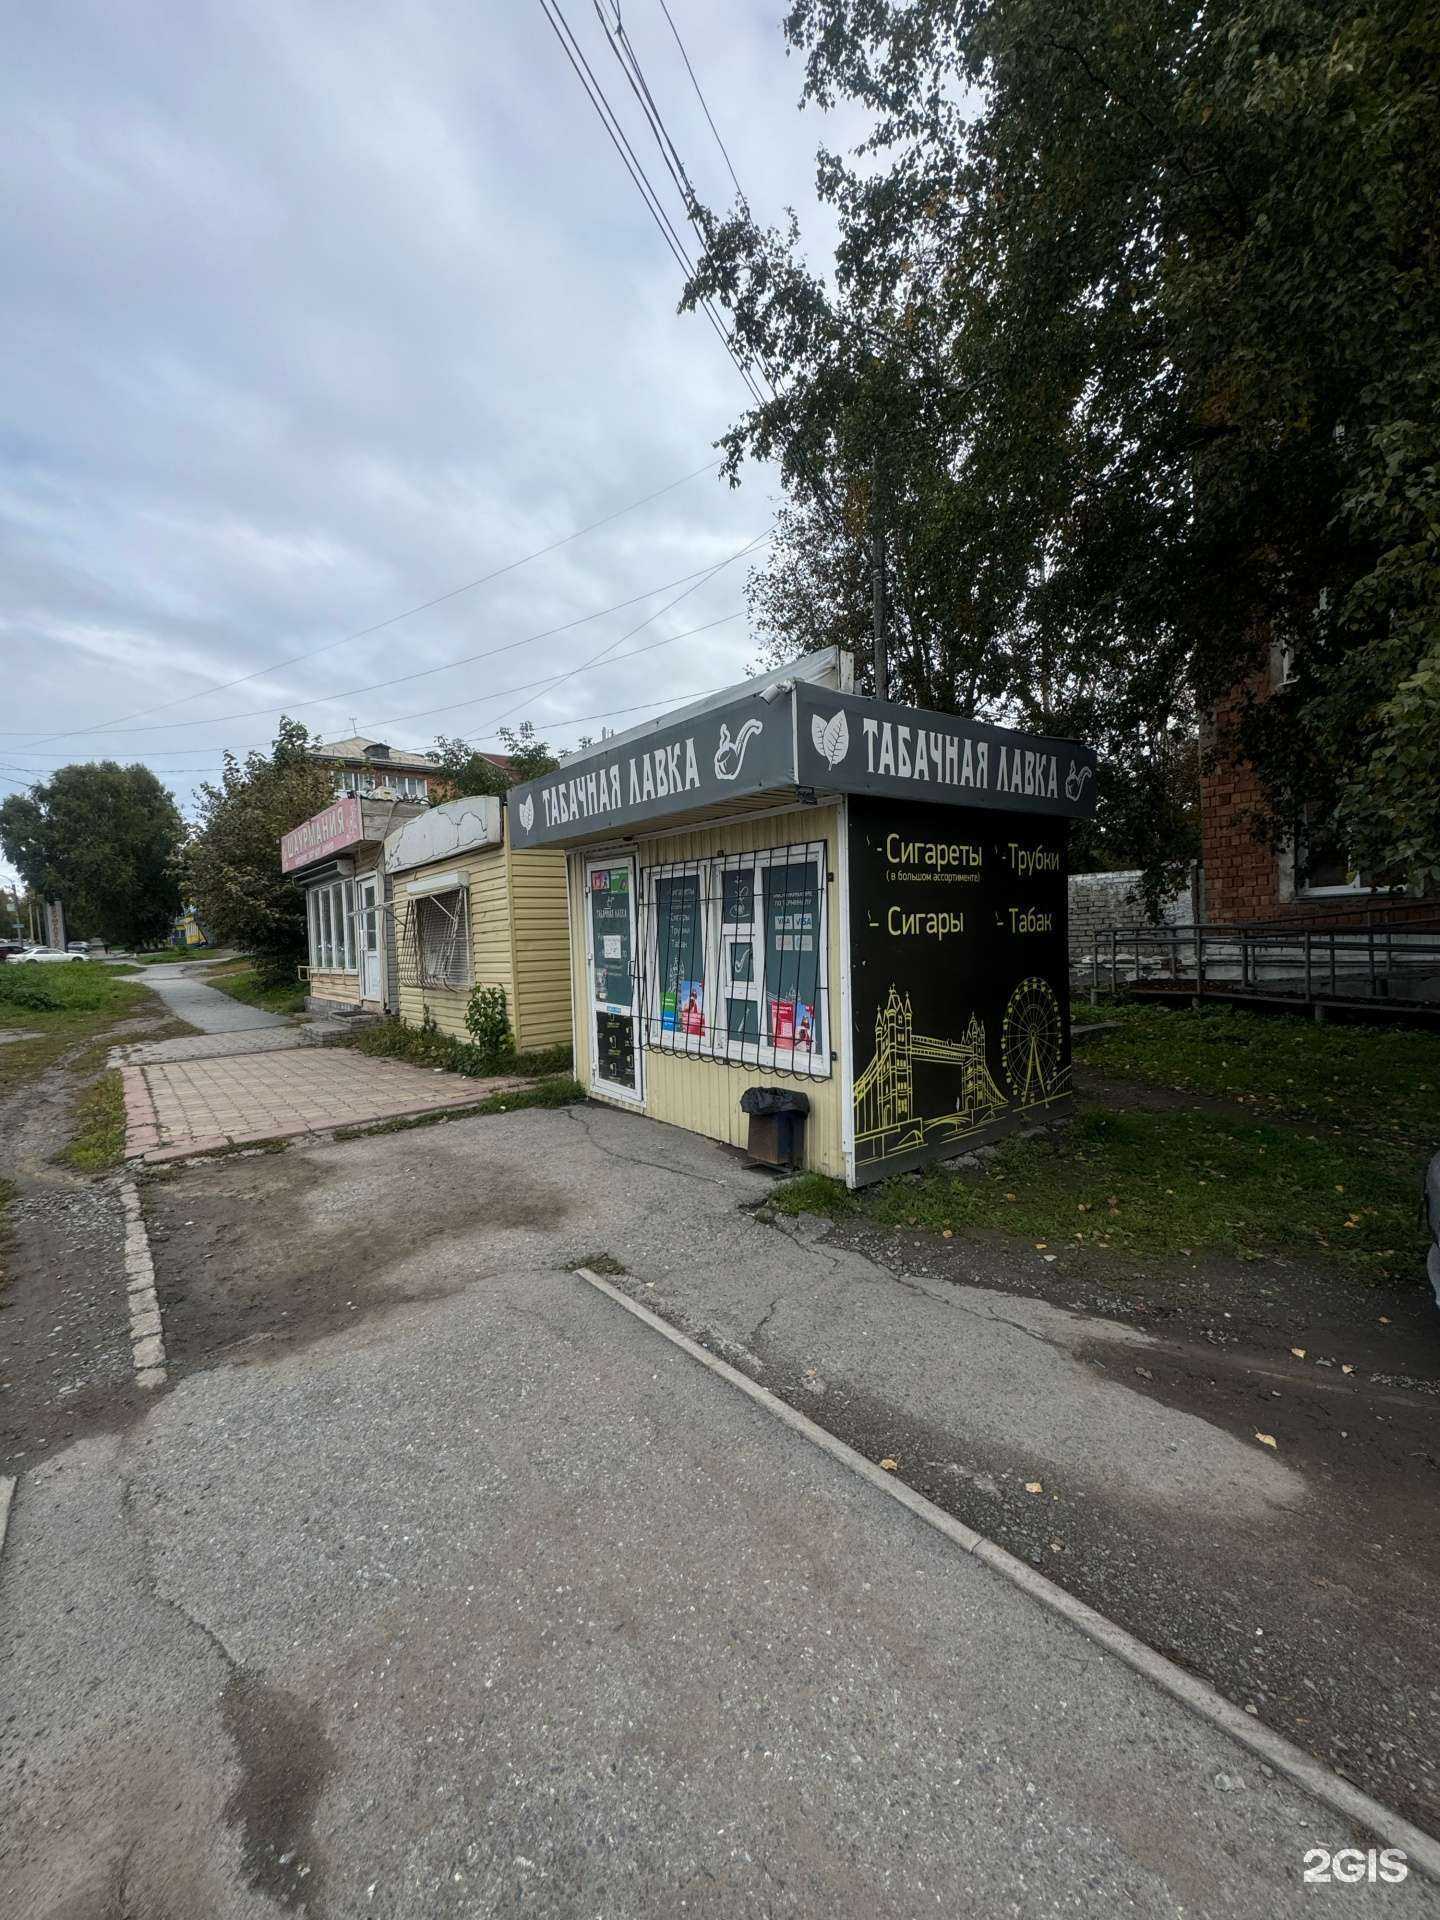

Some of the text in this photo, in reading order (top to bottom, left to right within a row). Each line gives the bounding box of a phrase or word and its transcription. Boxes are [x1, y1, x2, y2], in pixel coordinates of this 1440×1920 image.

[863, 718, 1059, 799] ТАБАЧНАЯ ЛАВКА
[542, 737, 701, 827] ТАБАЧНАЯ ЛАВКА
[886, 833, 982, 872] Сигареты
[1008, 843, 1060, 876] Трубки
[898, 870, 932, 881] большом
[887, 906, 964, 941] Сигары
[1008, 906, 1052, 934] Табак
